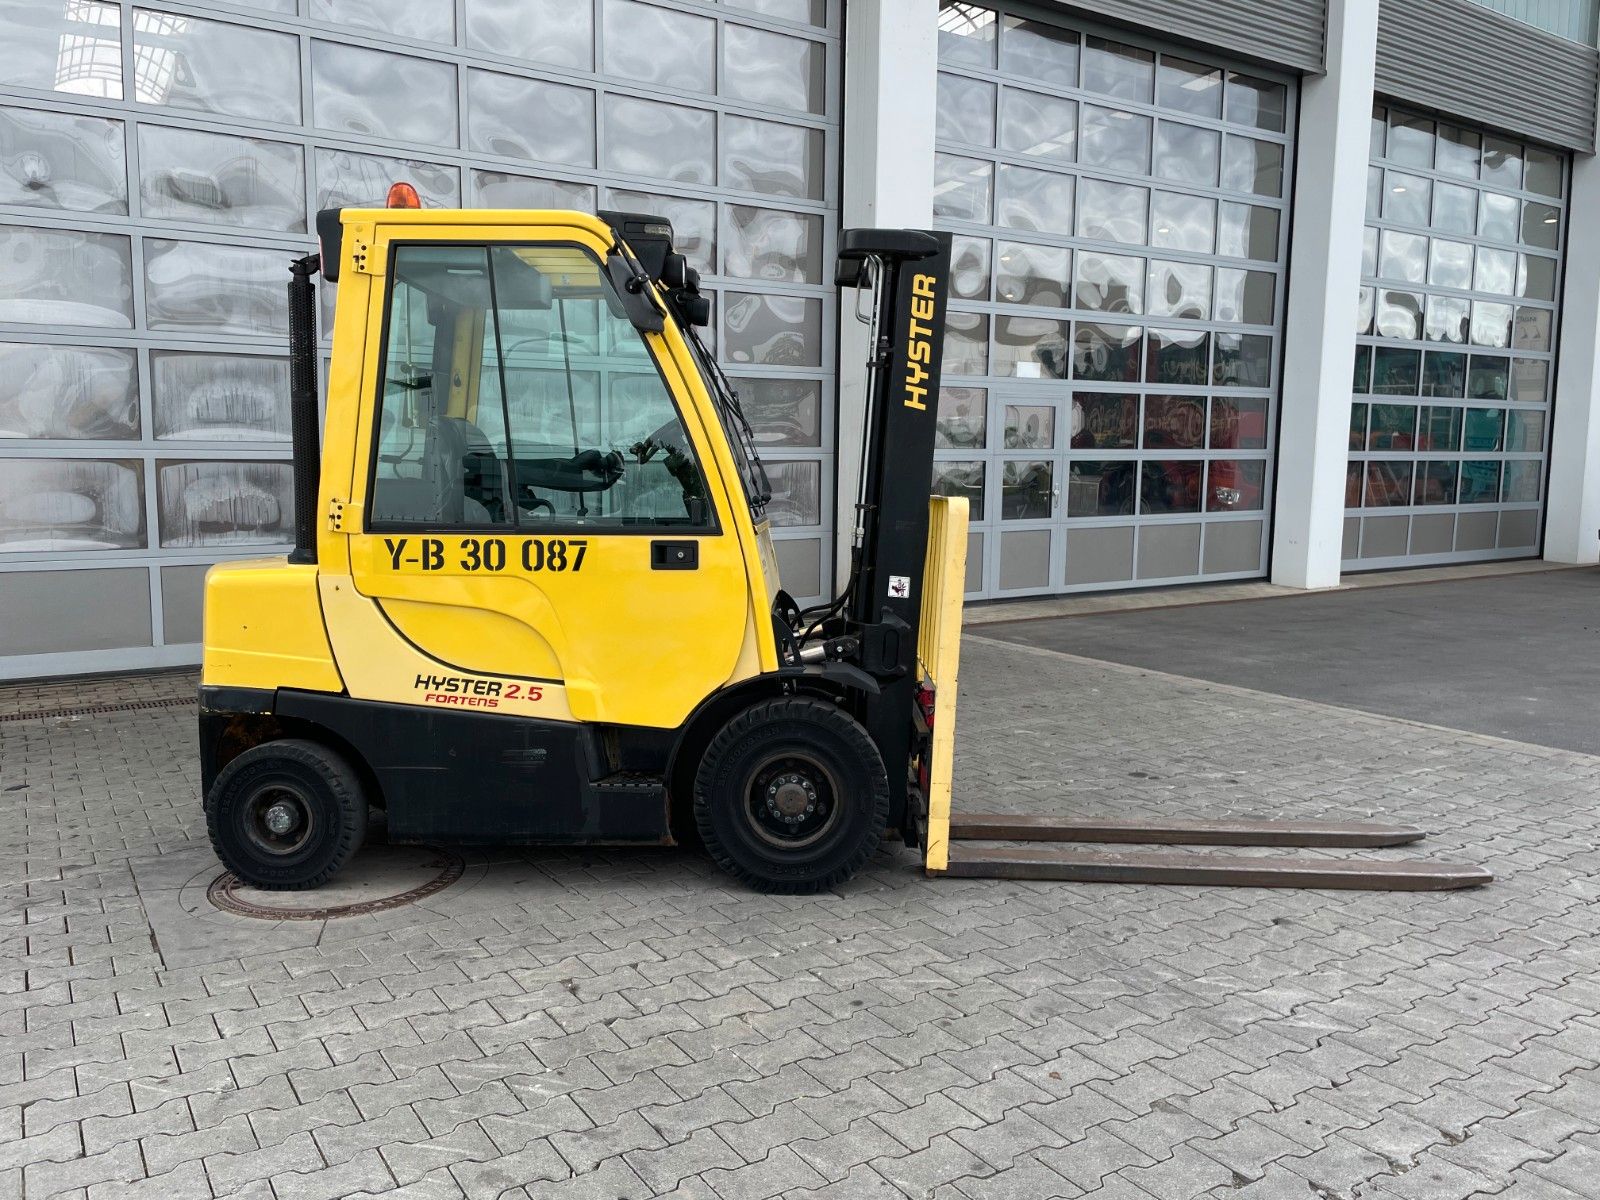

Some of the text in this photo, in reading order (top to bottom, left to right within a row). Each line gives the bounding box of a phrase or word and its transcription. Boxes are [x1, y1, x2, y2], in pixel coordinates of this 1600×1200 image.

[904, 273, 936, 411] HYSTER
[384, 538, 588, 572] Y-B 30 087
[414, 674, 543, 701] HYSTER 2.5
[425, 693, 499, 708] FORTENS
